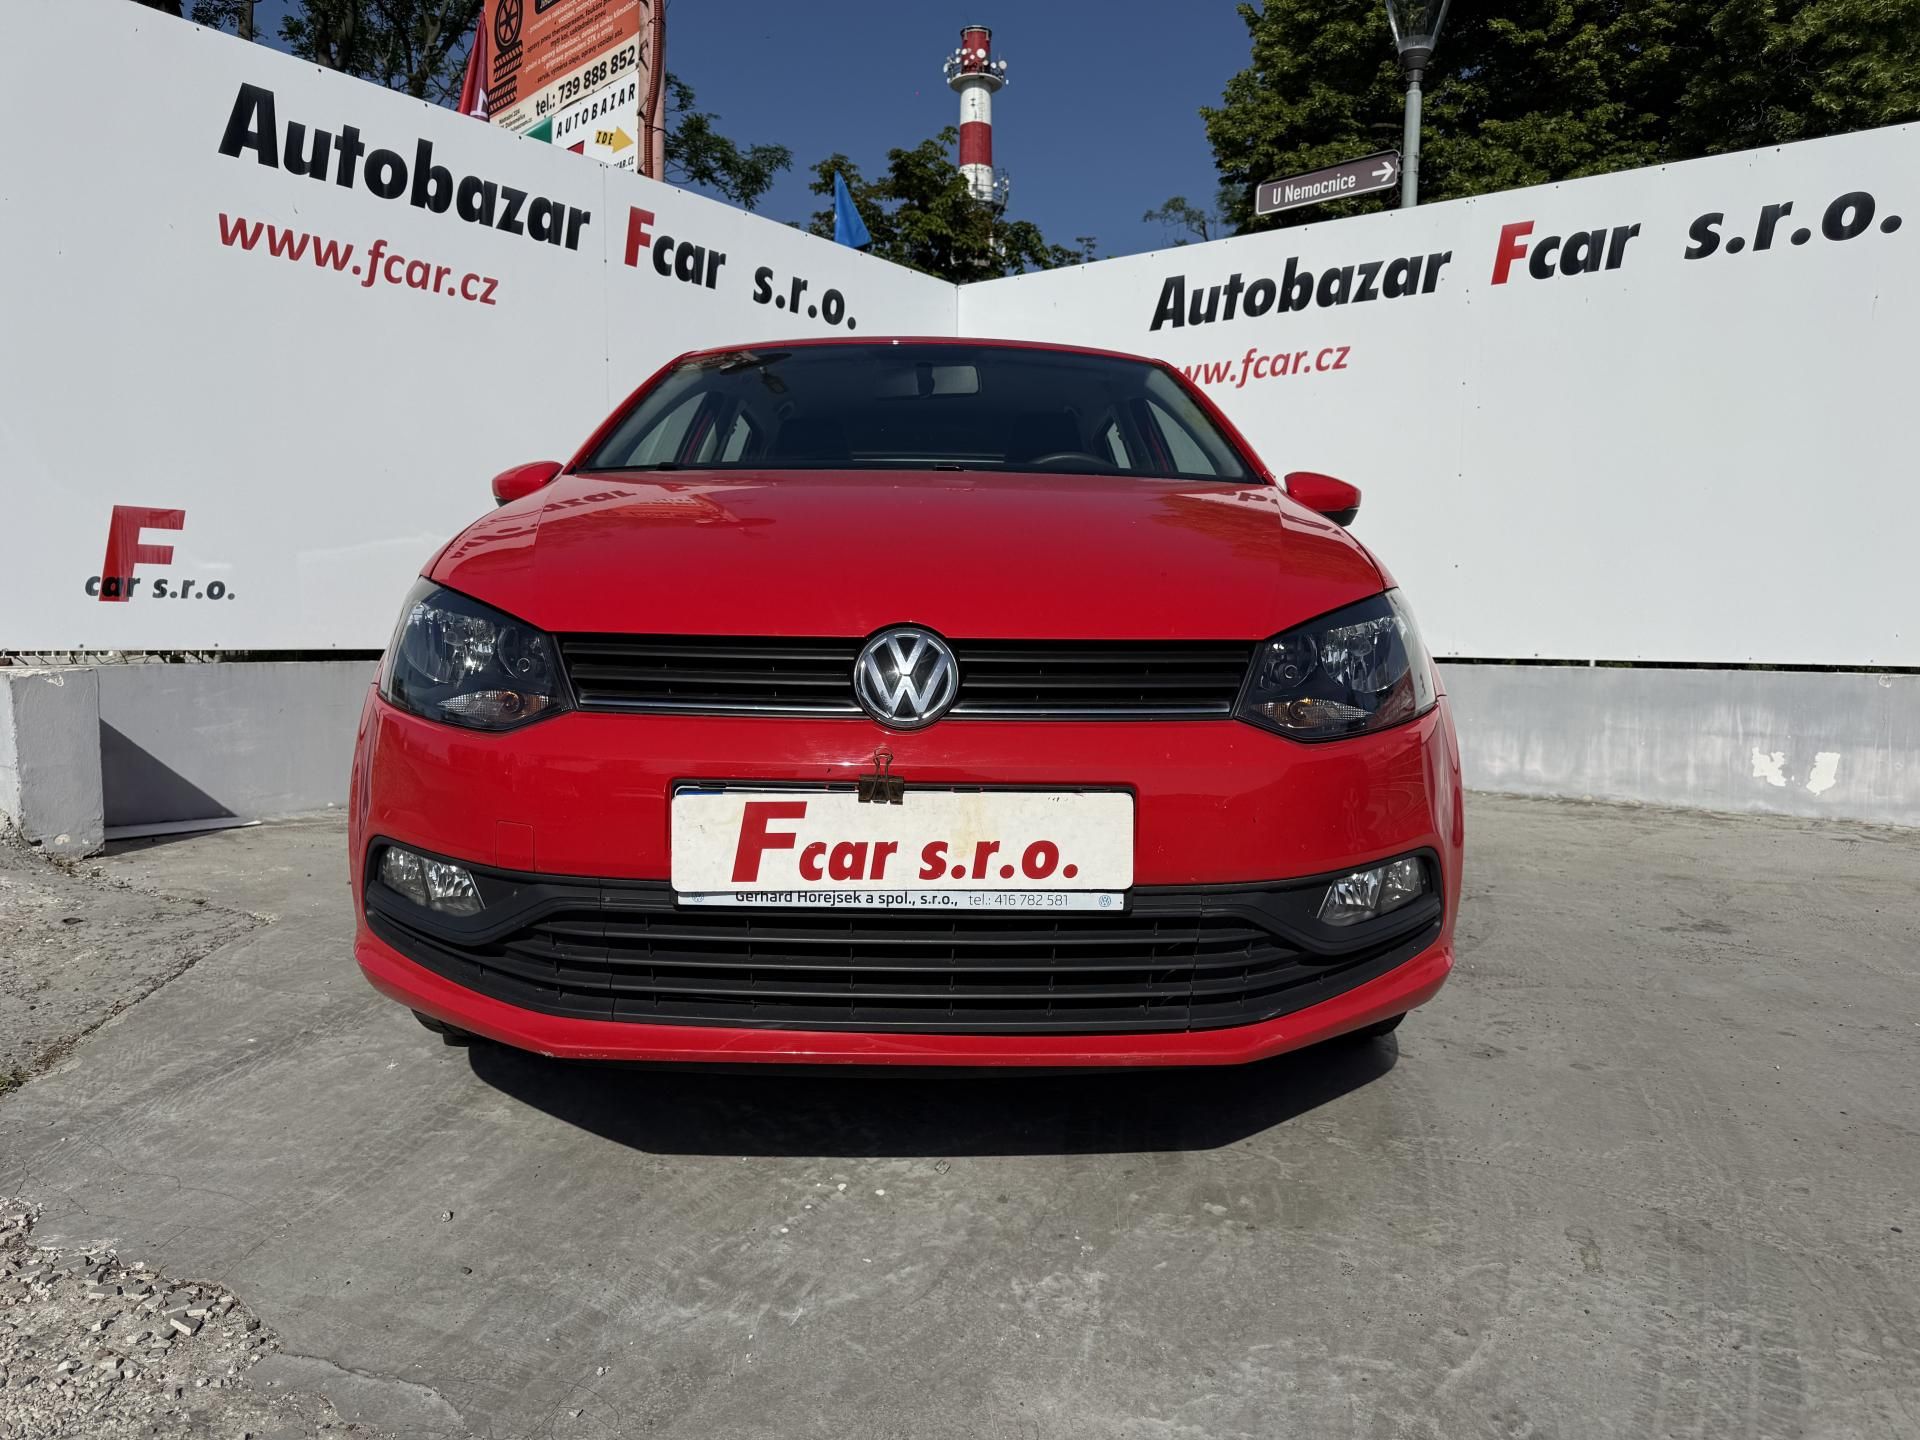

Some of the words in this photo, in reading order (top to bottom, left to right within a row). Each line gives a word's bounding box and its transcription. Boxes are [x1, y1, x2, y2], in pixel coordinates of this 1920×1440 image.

[536, 93, 556, 117] tel.:
[558, 77, 580, 104] 739
[583, 61, 607, 93] 888
[610, 45, 636, 74] 852
[556, 82, 636, 139] AUTOBAZAR
[595, 131, 613, 146] ZDE
[218, 83, 591, 251] Autobazar
[625, 205, 727, 290] Fcar
[752, 266, 856, 331] s.r.o.
[1272, 187, 1282, 205] U
[1284, 173, 1356, 203] Nemocnice
[218, 212, 499, 306] www.fcar.cz
[1149, 250, 1453, 331] Autobazar
[1490, 220, 1642, 285] Fcar
[1683, 191, 1904, 260] s.r.o.
[152, 578, 235, 601] s.r.o.
[919, 840, 1079, 881] s.r.o.
[735, 891, 793, 903] Gerhard
[866, 894, 874, 904] a
[878, 890, 915, 907] spol.,
[920, 894, 958, 907] s.r.o.,
[969, 893, 991, 906] tel.:
[994, 894, 1016, 906] 416
[1020, 894, 1043, 906] 782
[1047, 894, 1068, 906] 581
